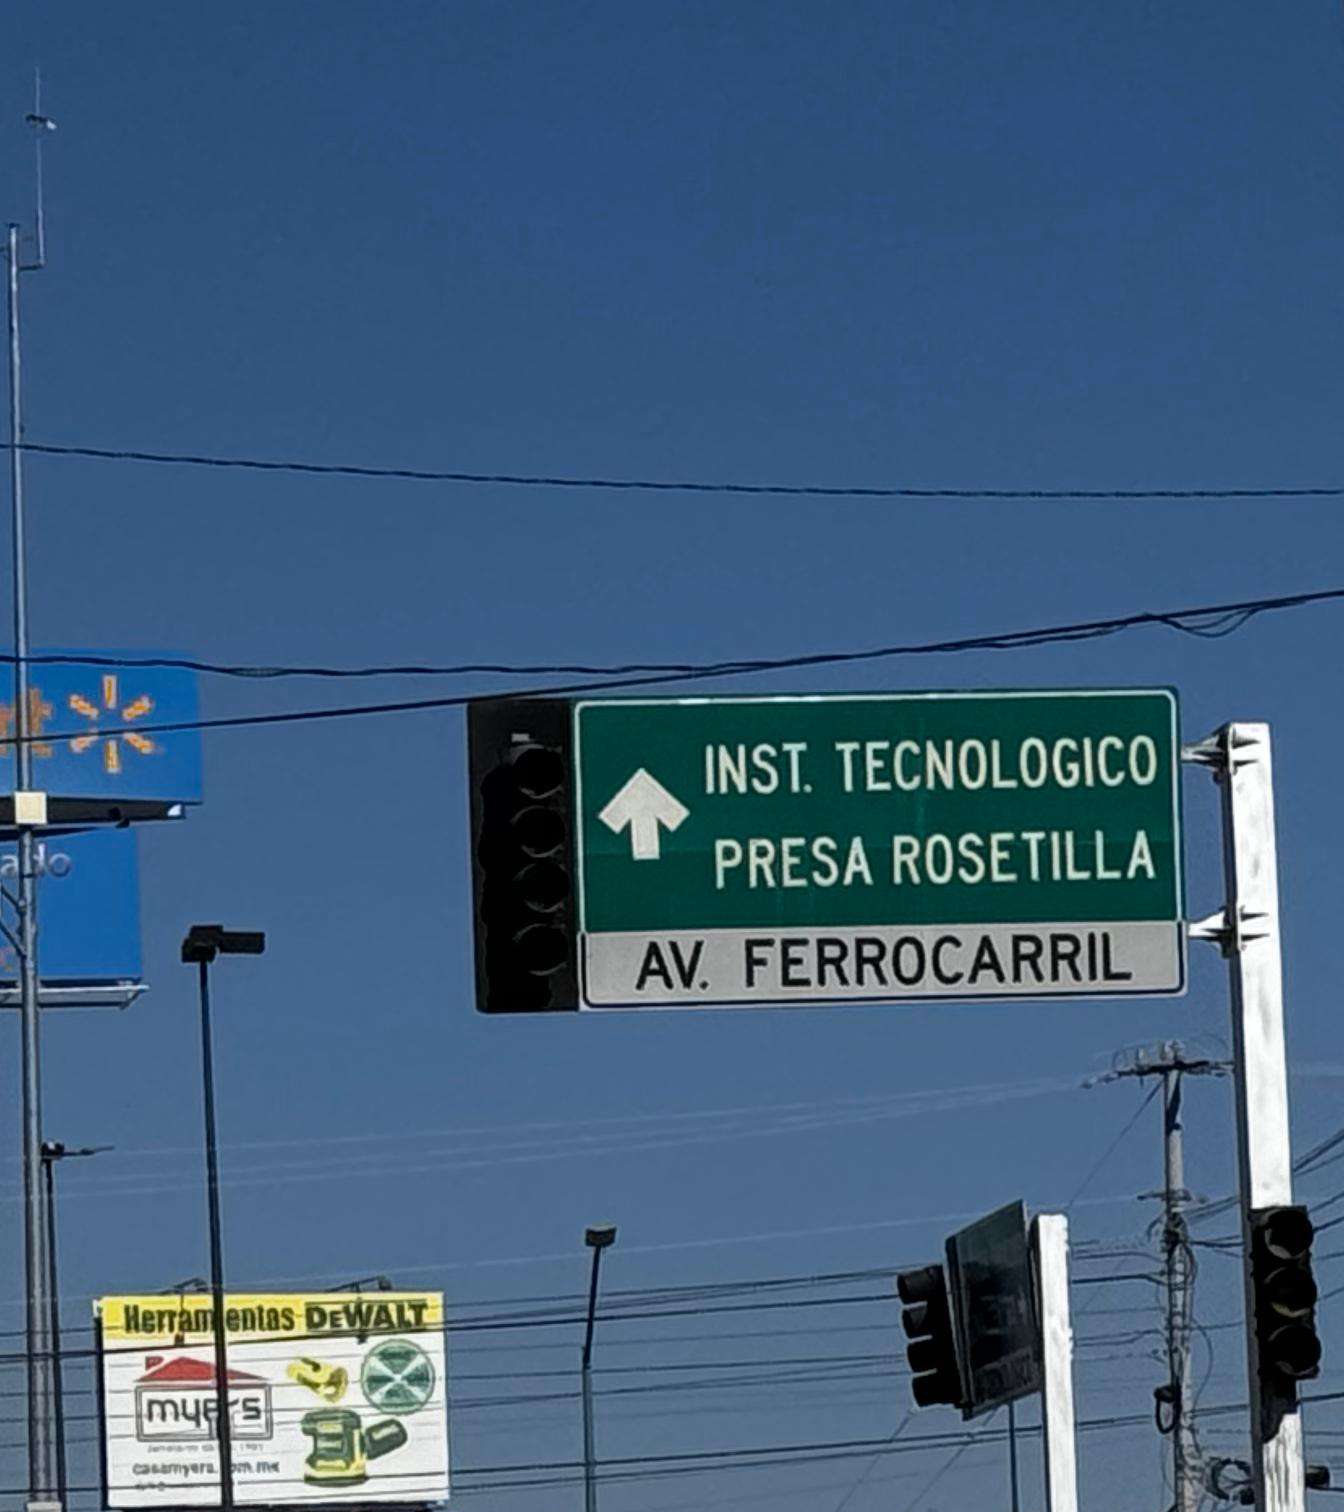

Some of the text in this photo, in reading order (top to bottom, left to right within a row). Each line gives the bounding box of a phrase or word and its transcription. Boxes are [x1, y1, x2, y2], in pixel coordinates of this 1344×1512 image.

[705, 735, 1158, 795] INST. TECNOLOGICO
[715, 830, 1156, 888] PRESA ROSETILLA
[636, 932, 1132, 991] AV. FERROCARRIL
[123, 1304, 295, 1334] Herramentas
